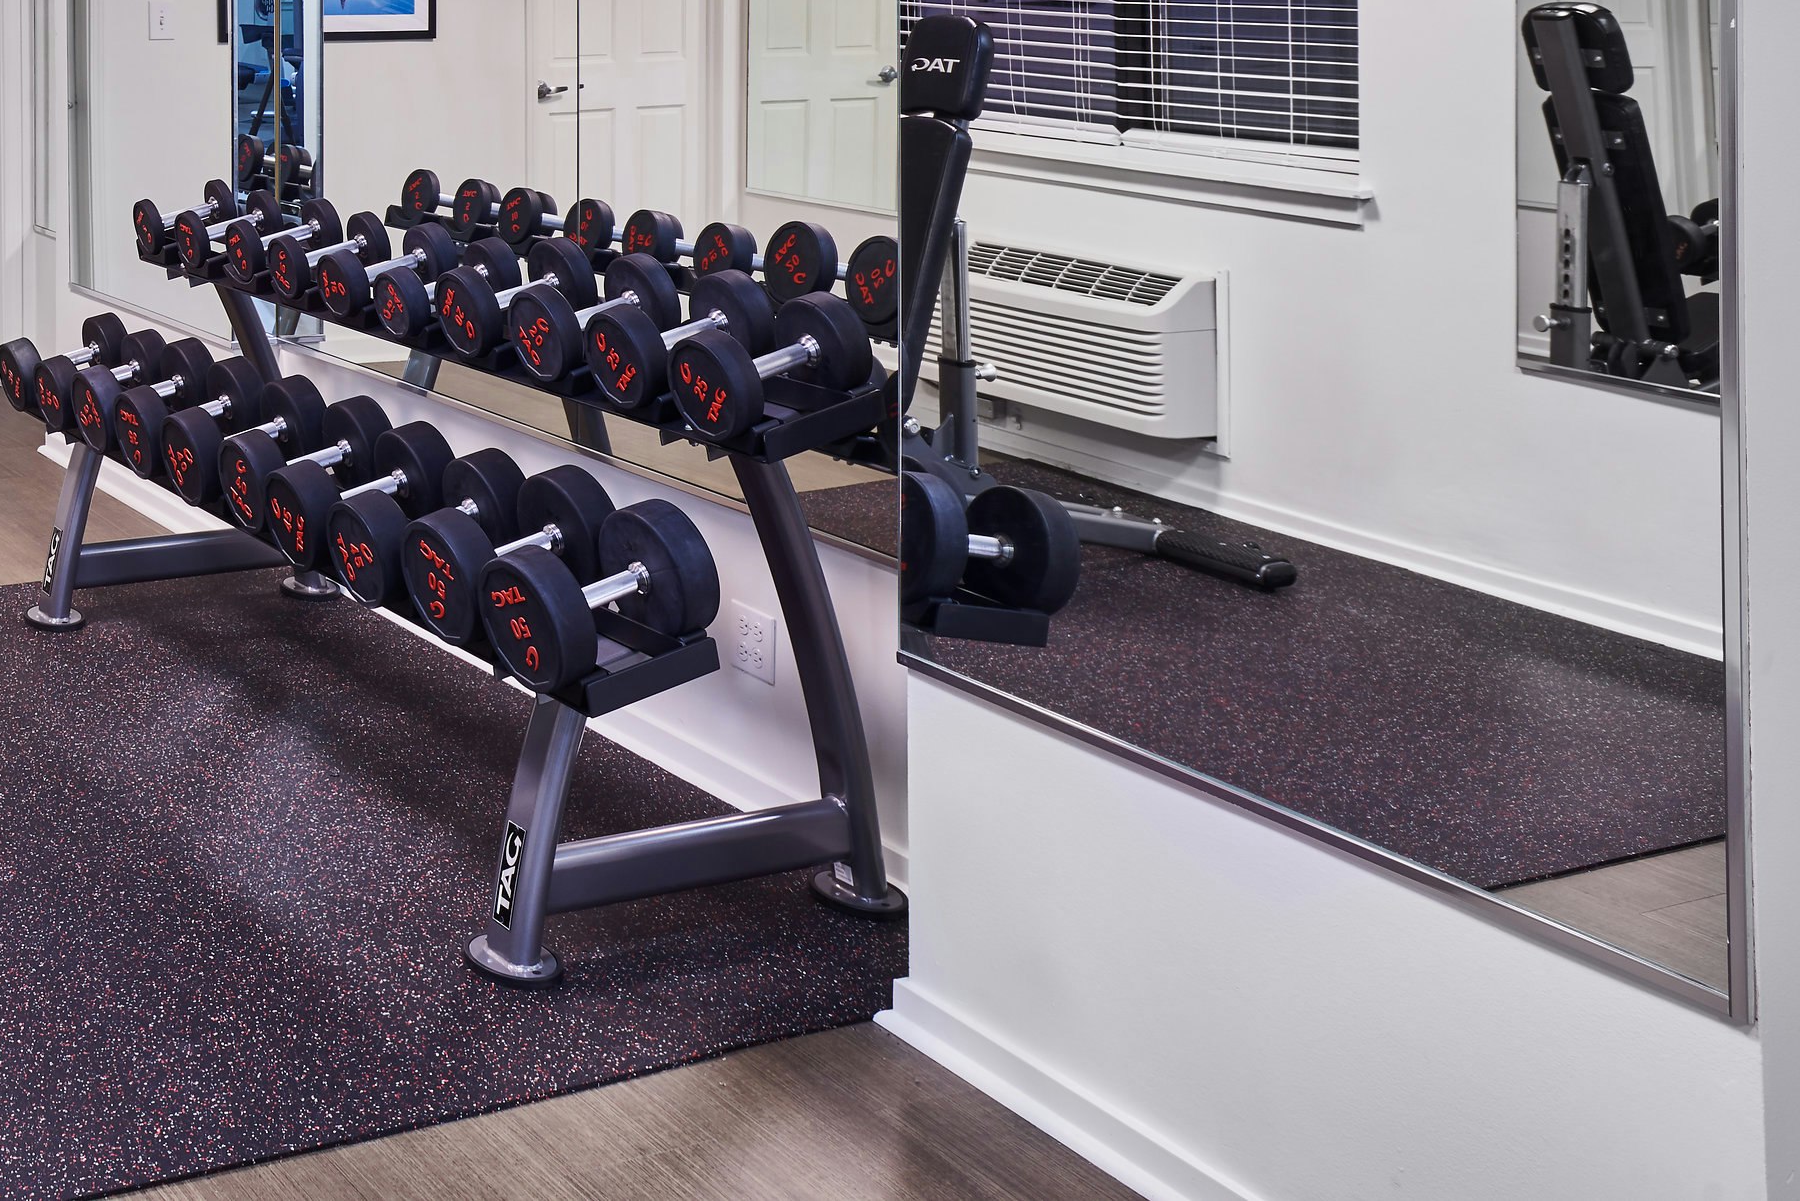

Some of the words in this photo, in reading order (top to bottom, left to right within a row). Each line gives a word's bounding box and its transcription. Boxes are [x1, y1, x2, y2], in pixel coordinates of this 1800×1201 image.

[322, 270, 330, 298] TAG
[387, 283, 403, 313] TAG
[442, 288, 455, 317] TAG
[454, 306, 464, 326] 20
[519, 326, 541, 366] TAG
[528, 325, 543, 346] 20
[606, 348, 620, 371] 25
[615, 363, 636, 392] TAG
[693, 375, 708, 402] 25
[120, 409, 138, 426] TAG
[707, 386, 727, 423] TAG
[128, 430, 138, 445] 35
[168, 444, 184, 486] TAG
[176, 451, 187, 472] 40
[235, 476, 247, 495] 40
[230, 486, 252, 520] TAG
[283, 507, 292, 533] 45
[296, 514, 304, 552] TAG
[337, 532, 356, 582] TAG
[350, 543, 364, 568] 45
[419, 540, 454, 581] TAG
[428, 572, 446, 600] 50
[491, 586, 526, 607] TAG
[510, 616, 531, 640] 50
